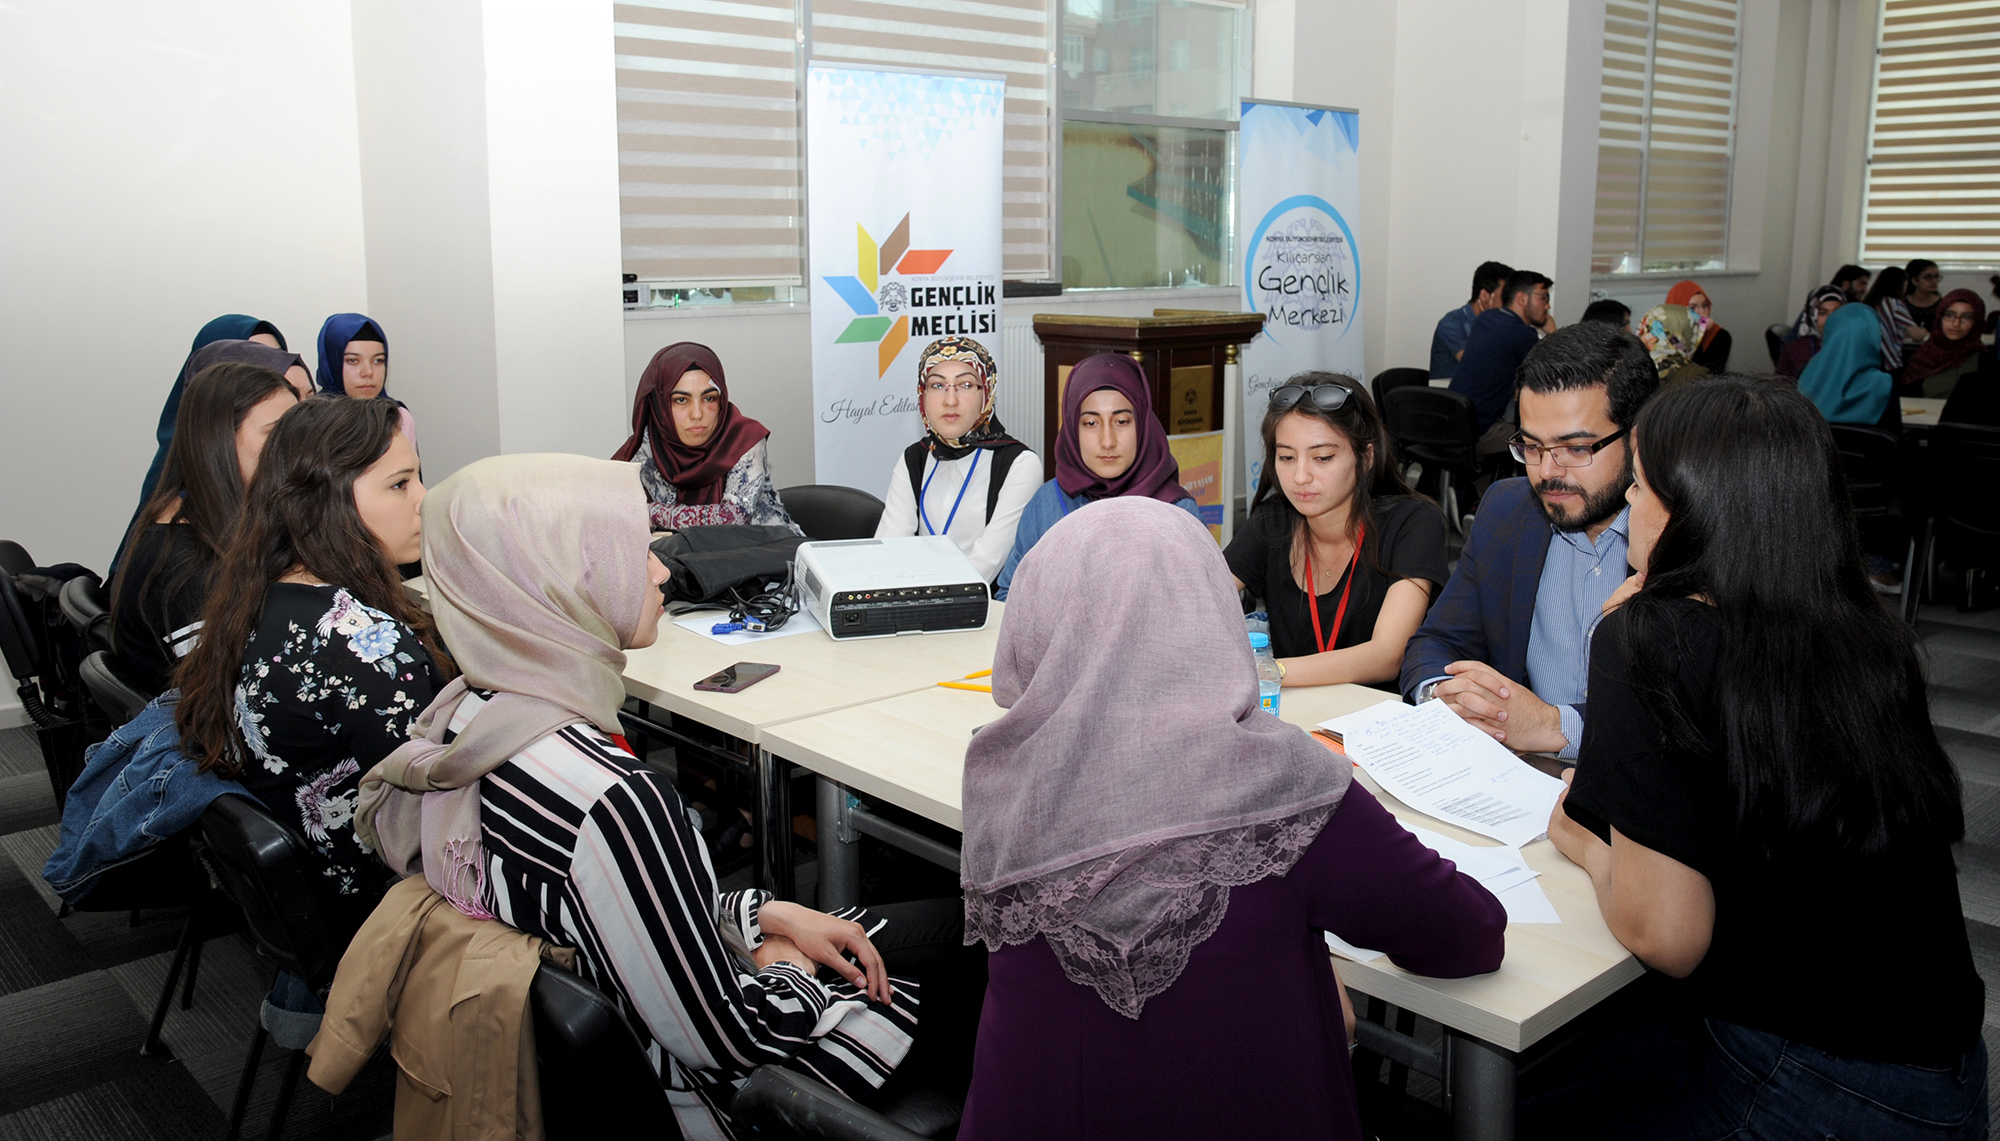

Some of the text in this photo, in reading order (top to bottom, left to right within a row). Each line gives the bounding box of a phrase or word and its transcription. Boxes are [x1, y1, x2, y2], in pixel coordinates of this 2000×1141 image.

[911, 281, 995, 311] GENÇLİK
[1258, 265, 1349, 301] Gençlik
[911, 309, 996, 336] MECLİSİ
[1268, 302, 1343, 325] Merkezi
[821, 398, 877, 425] Hayal
